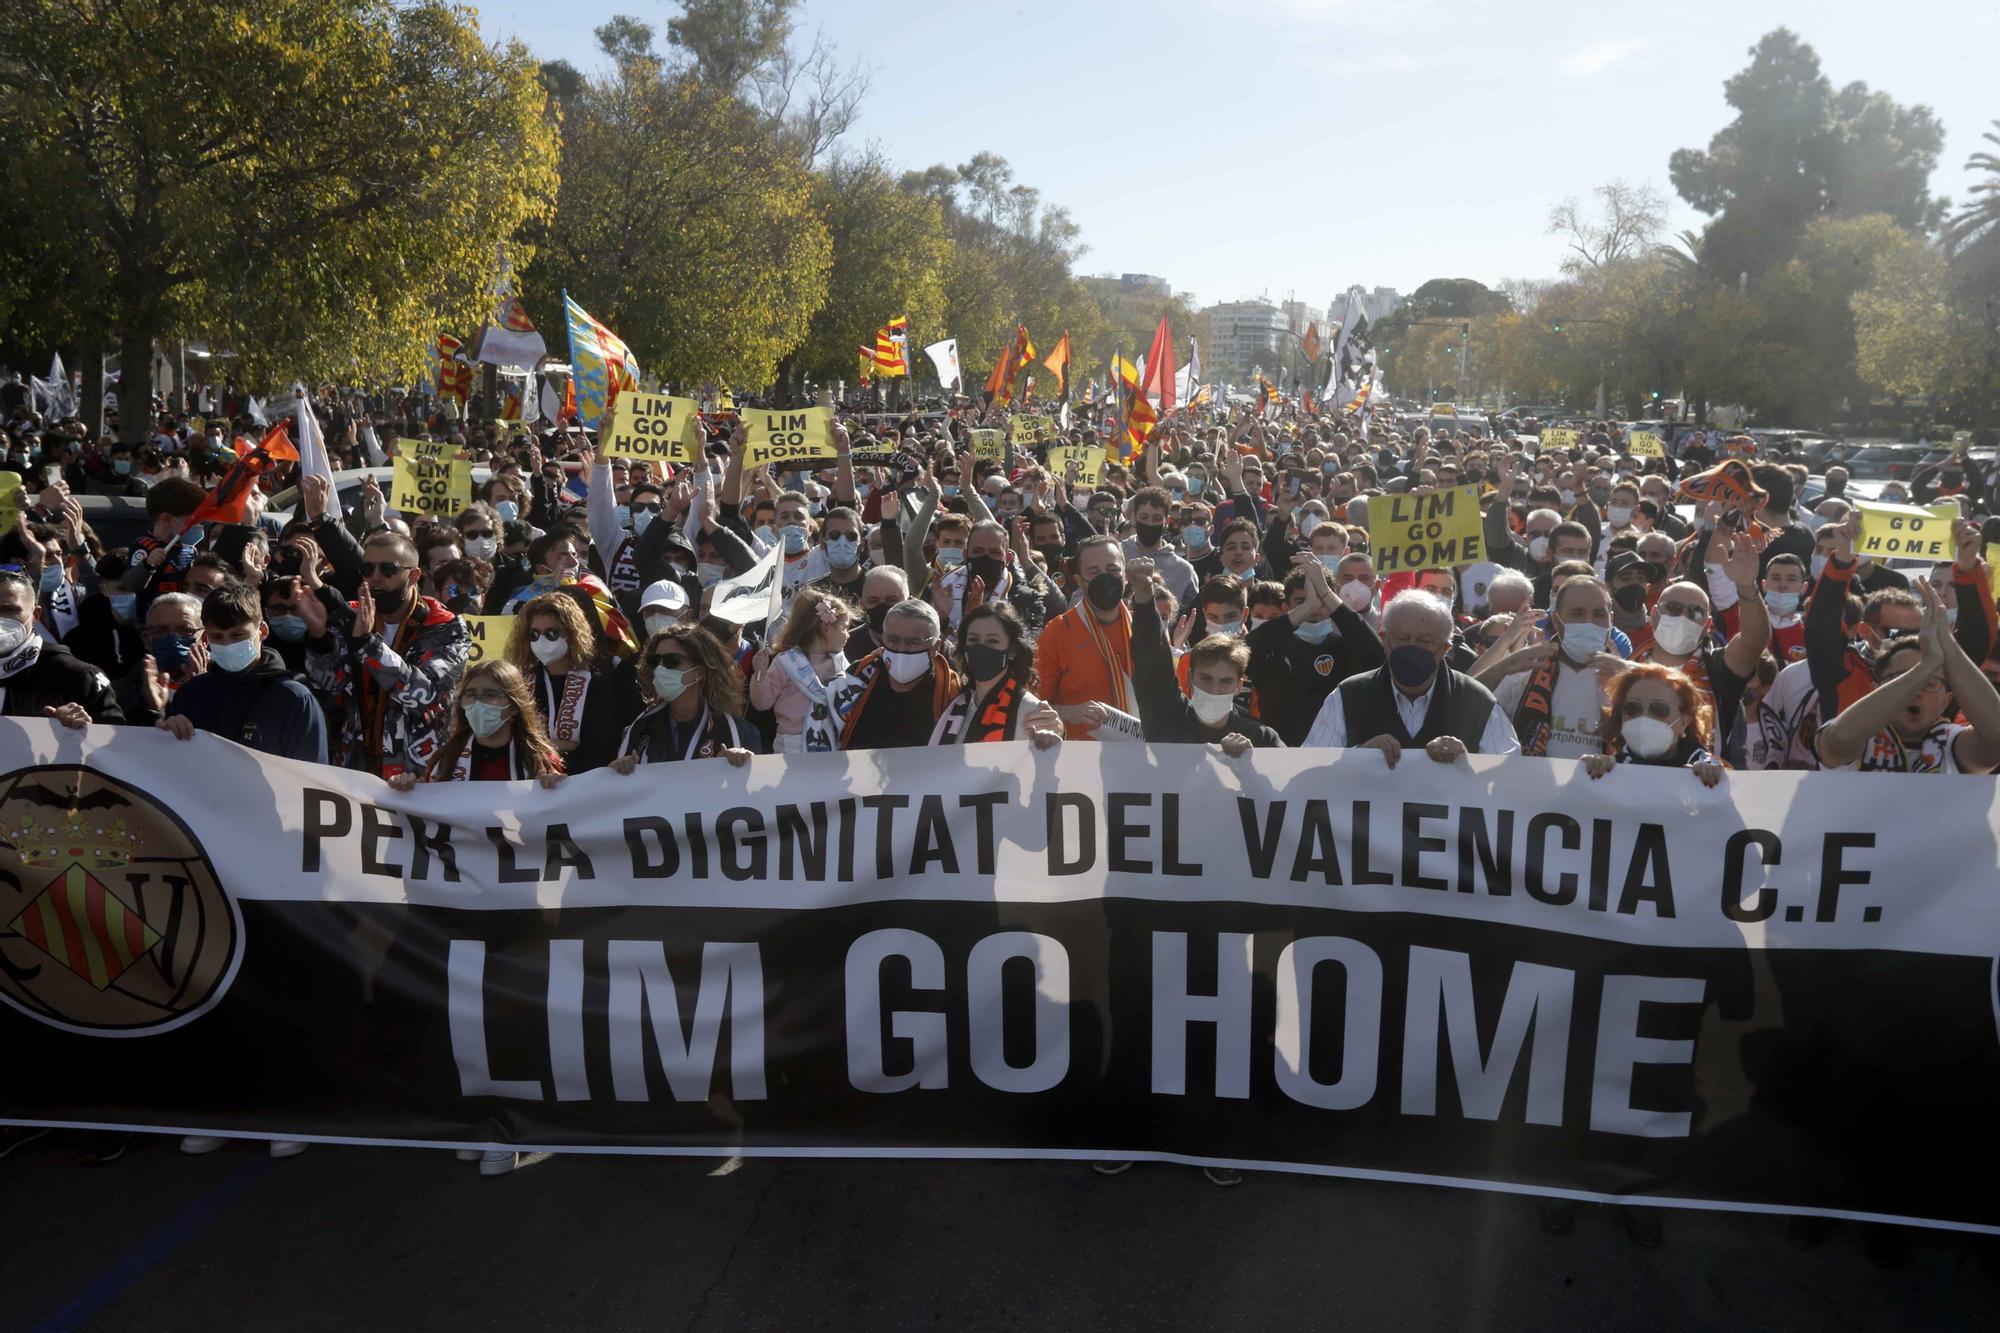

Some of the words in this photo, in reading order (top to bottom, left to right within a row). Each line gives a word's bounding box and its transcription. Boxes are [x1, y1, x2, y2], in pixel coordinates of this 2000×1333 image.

[632, 397, 672, 418] LIM
[634, 417, 668, 436] GO
[767, 414, 806, 431] LIM
[1023, 421, 1039, 431] GO
[769, 432, 804, 446] GO
[1016, 428, 1049, 442] HOE
[416, 443, 442, 455] LIM
[615, 435, 684, 457] HOME
[753, 447, 822, 462] HOME
[417, 464, 449, 478] LIM
[418, 480, 447, 494] GO
[401, 493, 461, 512] HOME
[1391, 491, 1454, 523] LIM
[1408, 522, 1442, 540] GO
[1890, 518, 1923, 531] GO
[1377, 536, 1480, 570] HOME
[1867, 537, 1942, 554] HOME
[302, 787, 461, 882] PER
[486, 823, 596, 884] LA
[623, 791, 1009, 882] DIGNITAT
[1046, 792, 1203, 876] DEL
[1237, 797, 1676, 918] VALENCIA
[1720, 829, 1882, 923] C.F.
[447, 939, 767, 1101] LIM
[845, 927, 1070, 1093] GO
[1151, 931, 1707, 1138] HOME
